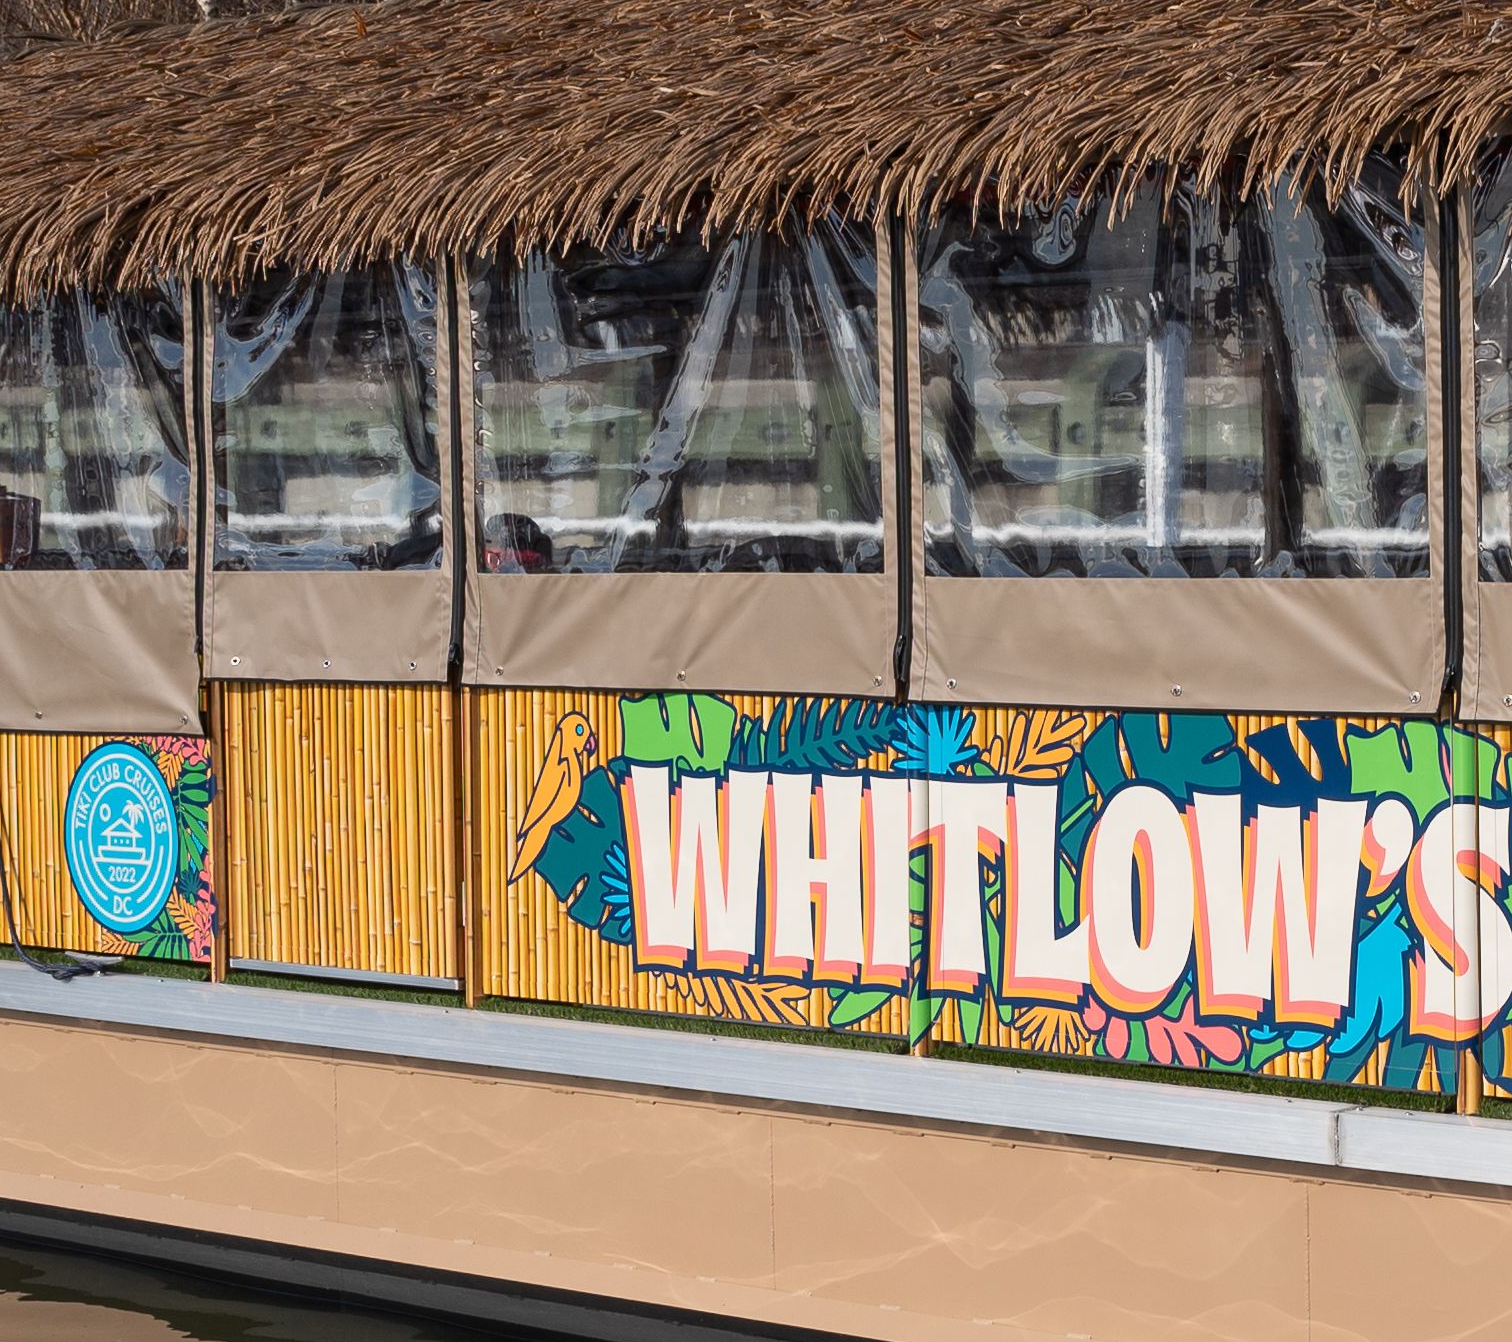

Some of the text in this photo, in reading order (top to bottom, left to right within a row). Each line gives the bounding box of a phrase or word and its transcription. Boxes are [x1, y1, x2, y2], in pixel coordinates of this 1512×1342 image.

[75, 762, 168, 835] TIKI CLUB CRUISES
[107, 866, 136, 884] 2022
[113, 895, 133, 915] DC
